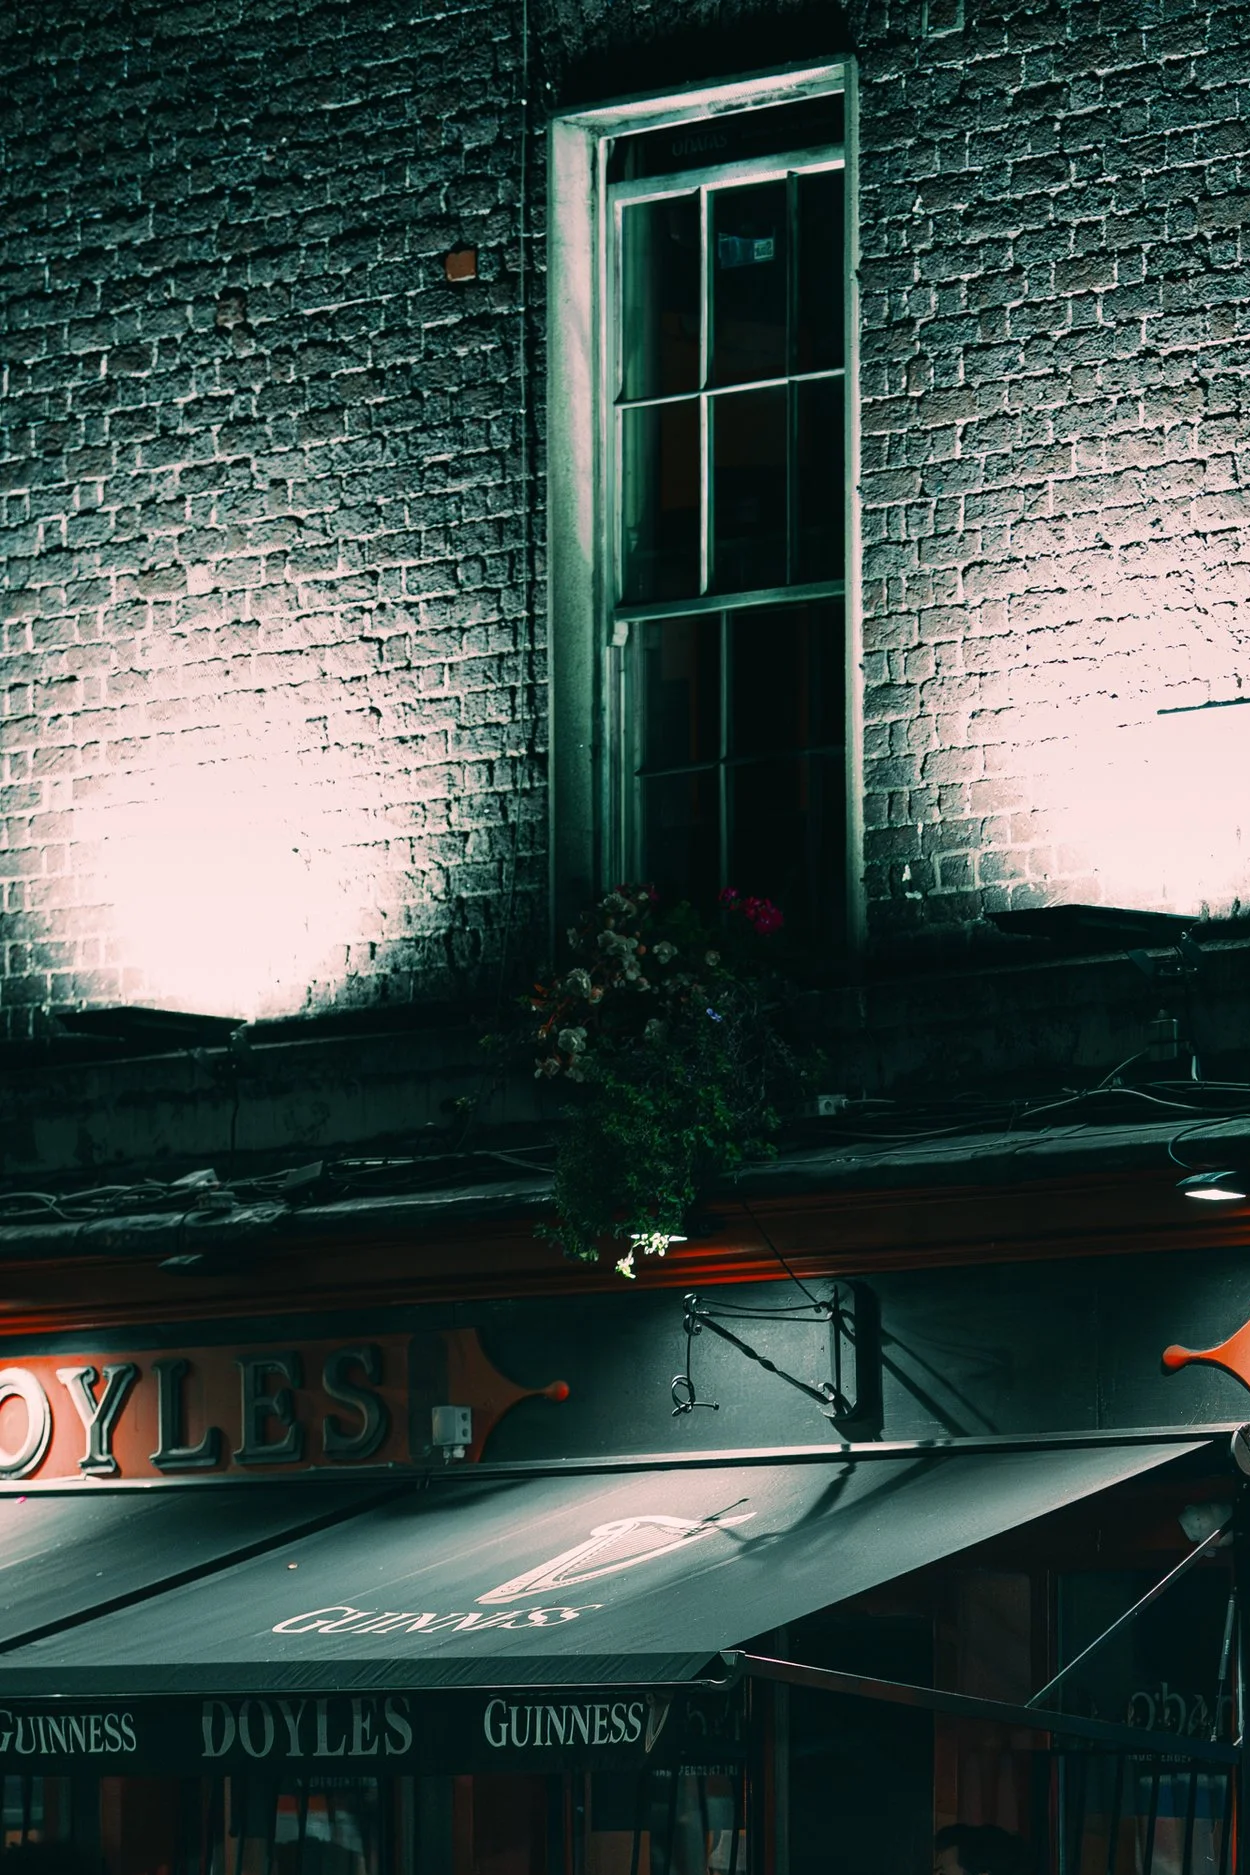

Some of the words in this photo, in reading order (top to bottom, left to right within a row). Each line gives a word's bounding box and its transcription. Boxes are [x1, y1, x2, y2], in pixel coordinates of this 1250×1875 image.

[271, 1604, 604, 1634] GUINNESS
[202, 1697, 413, 1758] DOYLES
[484, 1699, 643, 1747] GUINNESS
